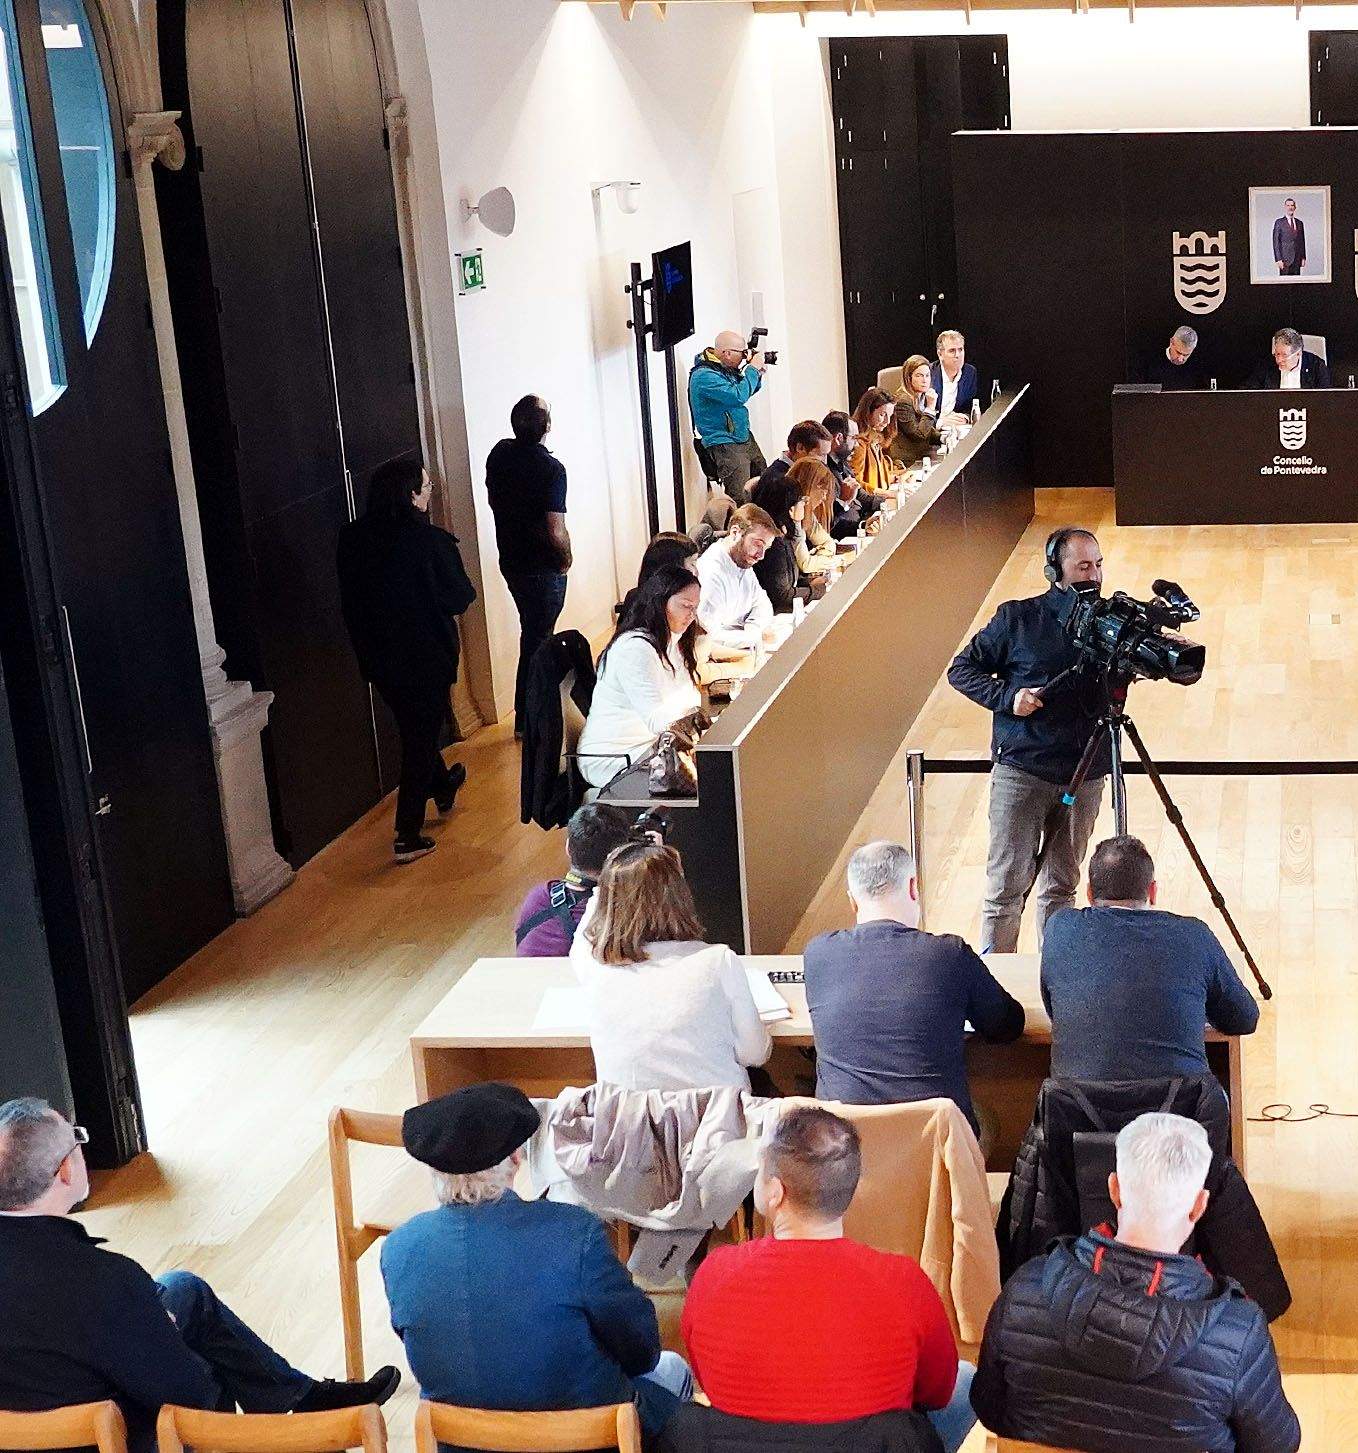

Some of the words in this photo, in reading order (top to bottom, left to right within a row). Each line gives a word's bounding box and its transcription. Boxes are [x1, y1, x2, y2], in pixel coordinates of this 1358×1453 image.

[1273, 456, 1313, 465] Concello
[1260, 466, 1272, 475] de
[1273, 465, 1327, 475] Pontevedra
